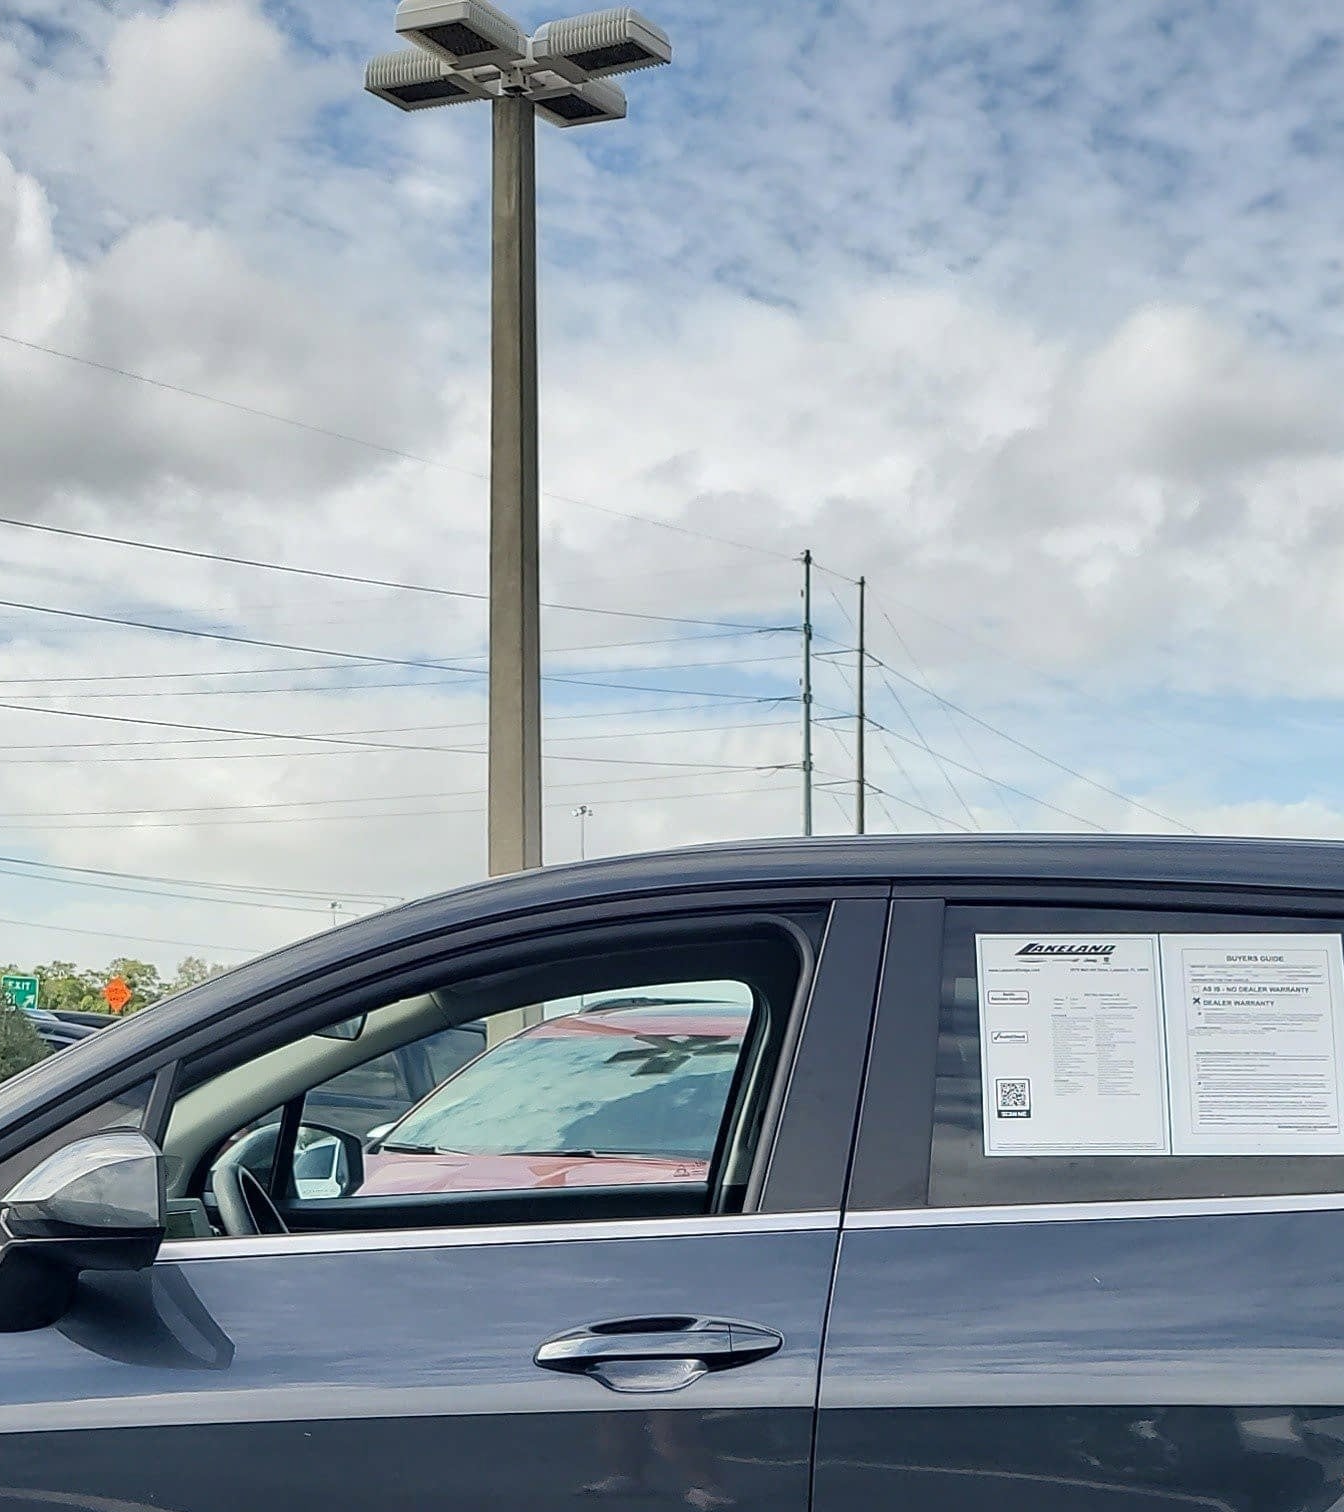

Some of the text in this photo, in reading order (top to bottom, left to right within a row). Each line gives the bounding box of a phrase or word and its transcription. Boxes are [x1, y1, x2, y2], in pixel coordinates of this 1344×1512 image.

[1015, 943, 1116, 955] LAKELAND
[8, 981, 31, 990] EXIT
[1269, 986, 1309, 994] WARRANTY
